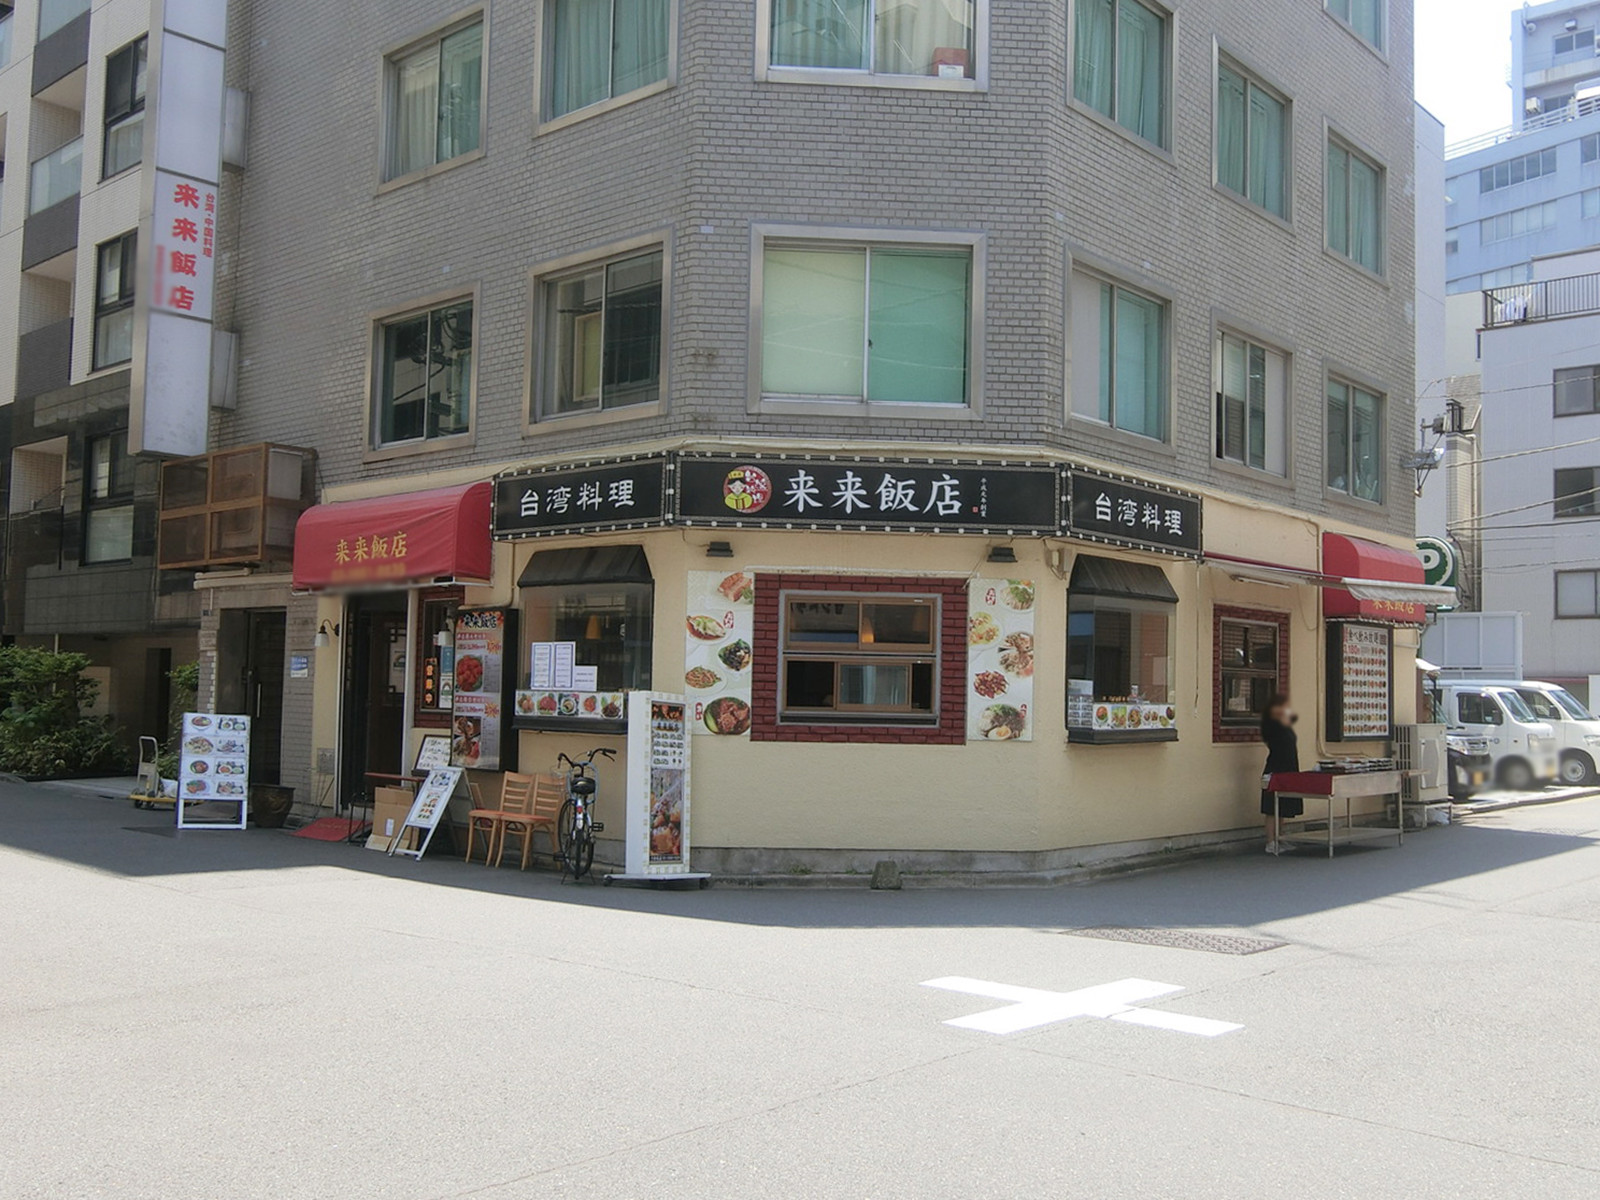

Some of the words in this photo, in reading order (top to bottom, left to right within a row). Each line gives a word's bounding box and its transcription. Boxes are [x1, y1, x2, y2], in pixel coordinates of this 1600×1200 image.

[169, 184, 200, 310] 来来飯店
[520, 479, 635, 517] 台湾料理
[783, 469, 963, 517] 来来飯店
[1095, 492, 1183, 536] 台湾料理
[334, 531, 408, 565] 来来飯店
